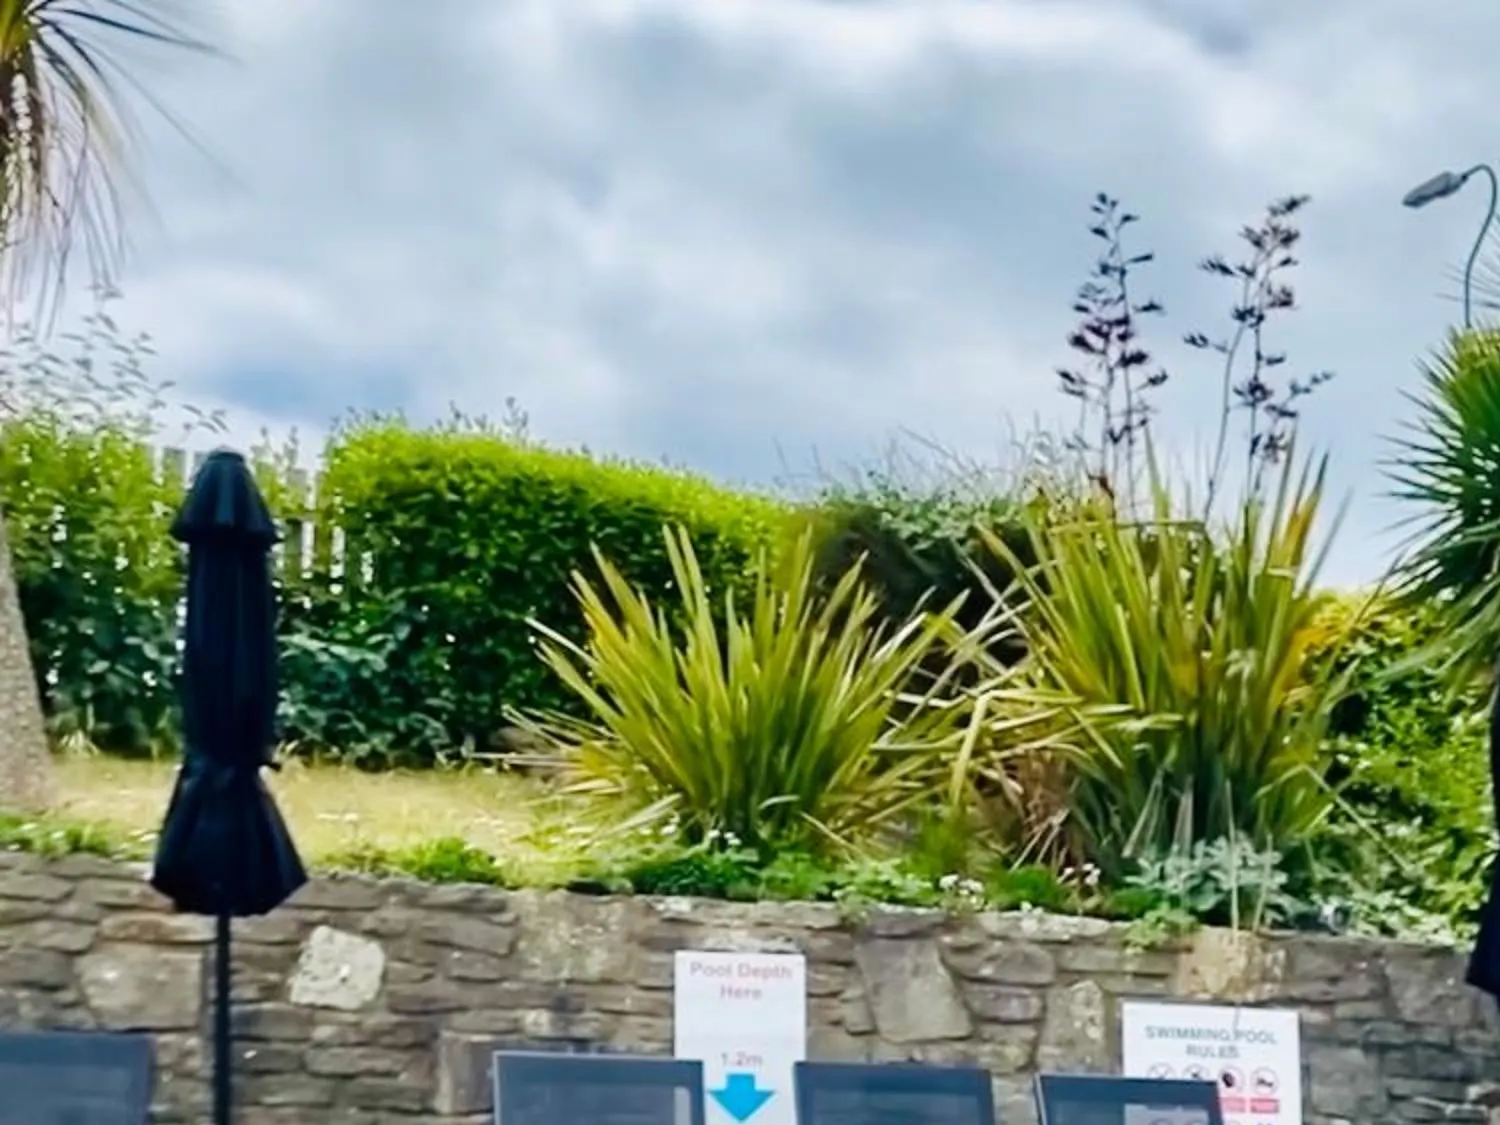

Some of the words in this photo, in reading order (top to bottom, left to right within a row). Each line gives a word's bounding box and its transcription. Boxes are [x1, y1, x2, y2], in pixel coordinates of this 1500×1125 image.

[690, 962, 732, 977] Pool
[737, 963, 794, 980] Depth
[720, 985, 763, 999] Here
[1145, 1026, 1230, 1042] SWIMMING
[1234, 1029, 1277, 1044] POOL
[1186, 1043, 1240, 1058] RULES
[721, 1052, 763, 1067] 1.2m
